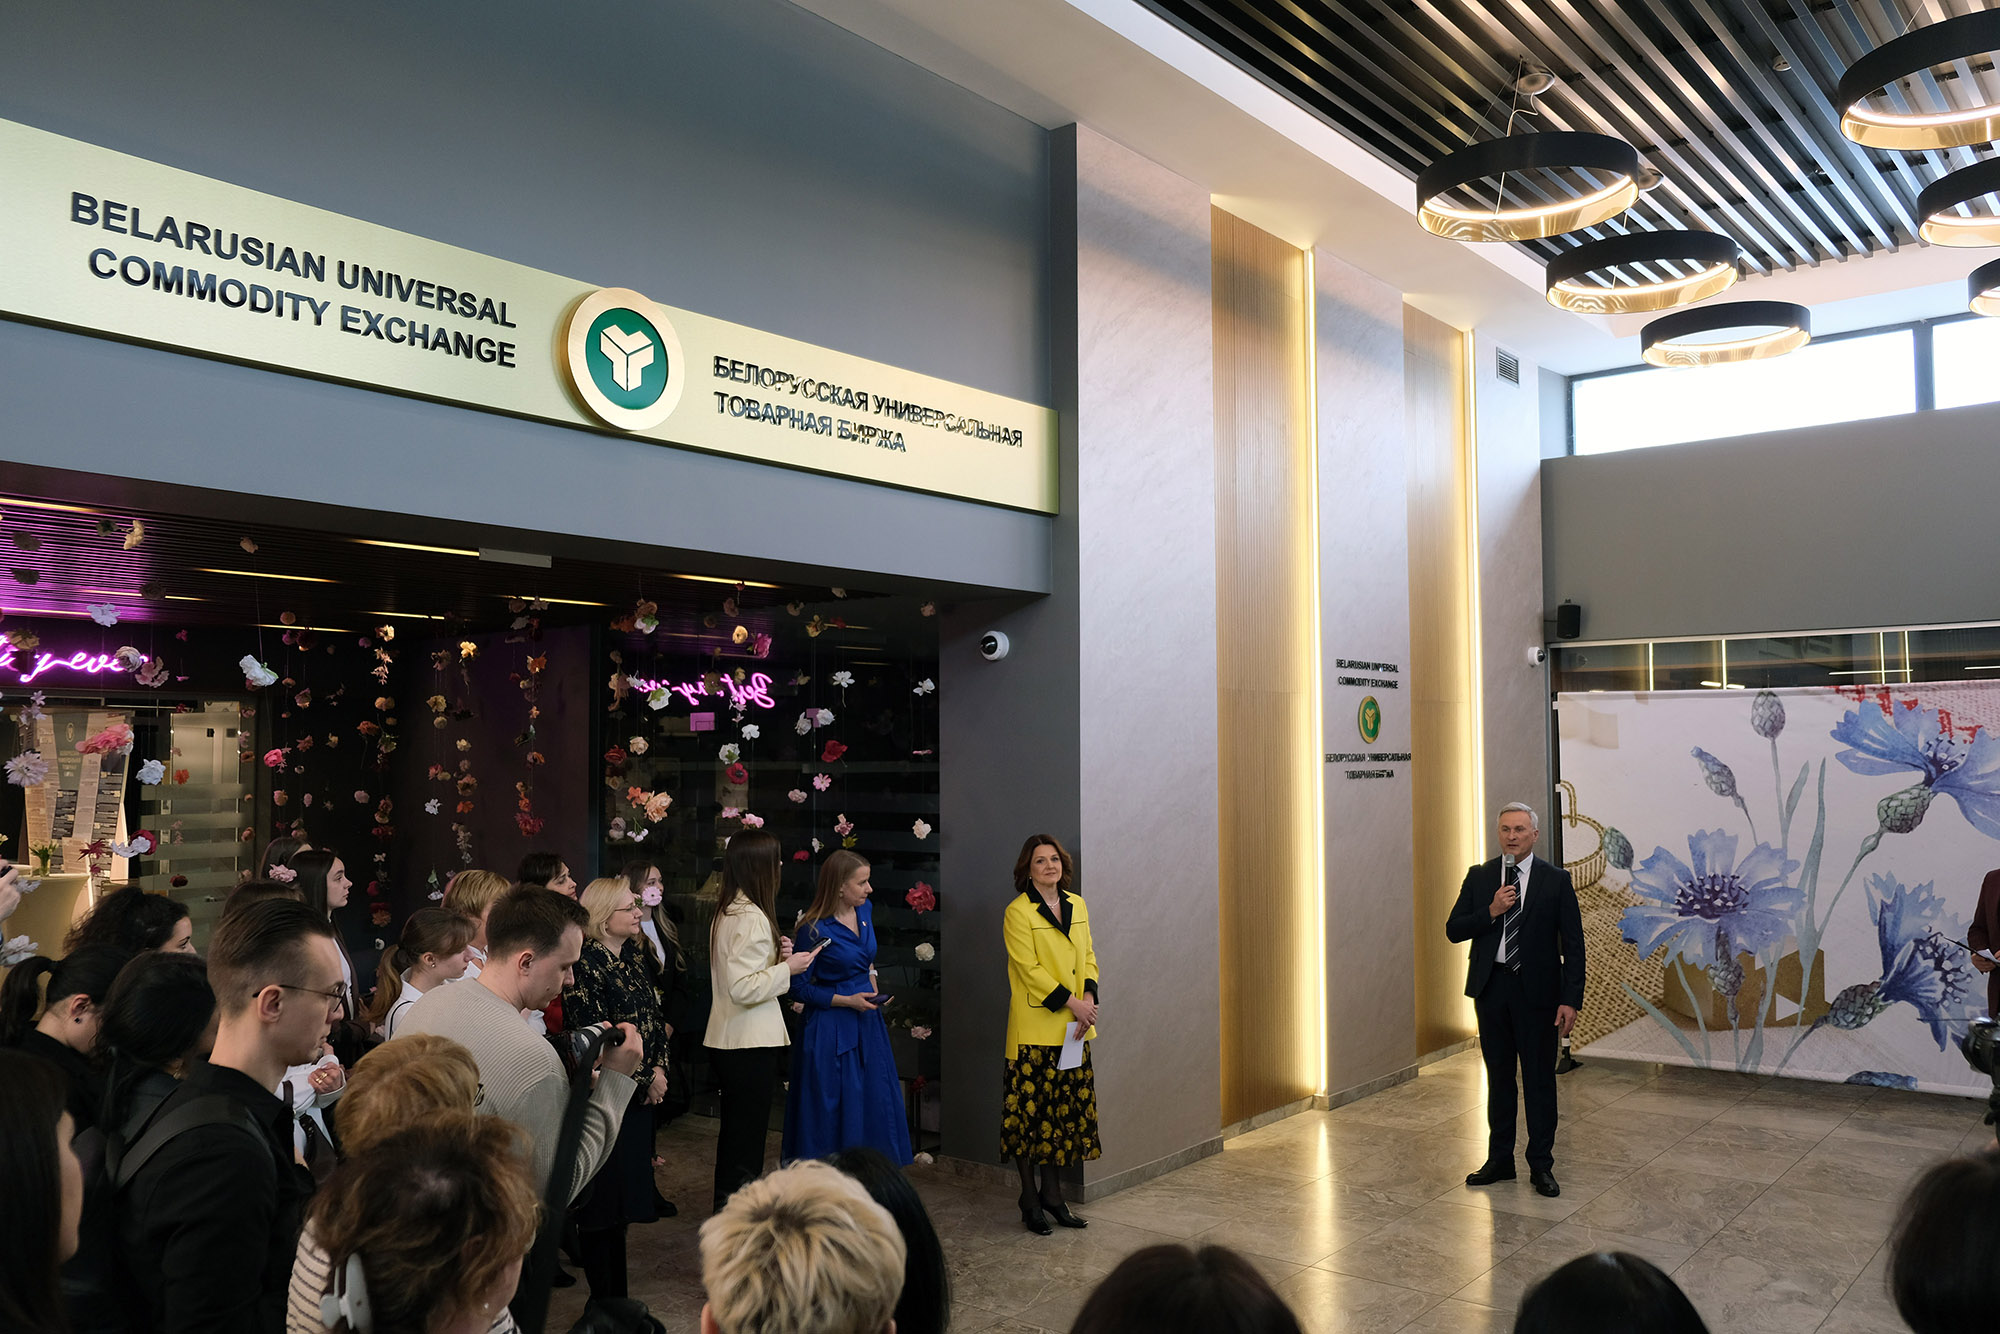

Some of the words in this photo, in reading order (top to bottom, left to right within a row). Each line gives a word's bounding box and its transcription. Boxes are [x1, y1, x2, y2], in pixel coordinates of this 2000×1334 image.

[71, 191, 326, 283] BELARUSIAN
[337, 260, 517, 329] UNIVERSAL
[88, 248, 332, 326] COMMODITY
[340, 305, 516, 369] EXCHANGE
[713, 355, 869, 412] БЕЛОРУССКАЯ
[872, 394, 1023, 448] УНИВЕРСАЛЬНАЯ
[713, 391, 833, 437] ТОВАРНАЯ
[837, 419, 907, 452] БИРЖА
[1336, 659, 1370, 670] BELARUSIAN
[1371, 662, 1399, 673] UNIVERSAL
[1338, 676, 1370, 686] COMMODITY
[1371, 679, 1399, 689] EXCHANGE
